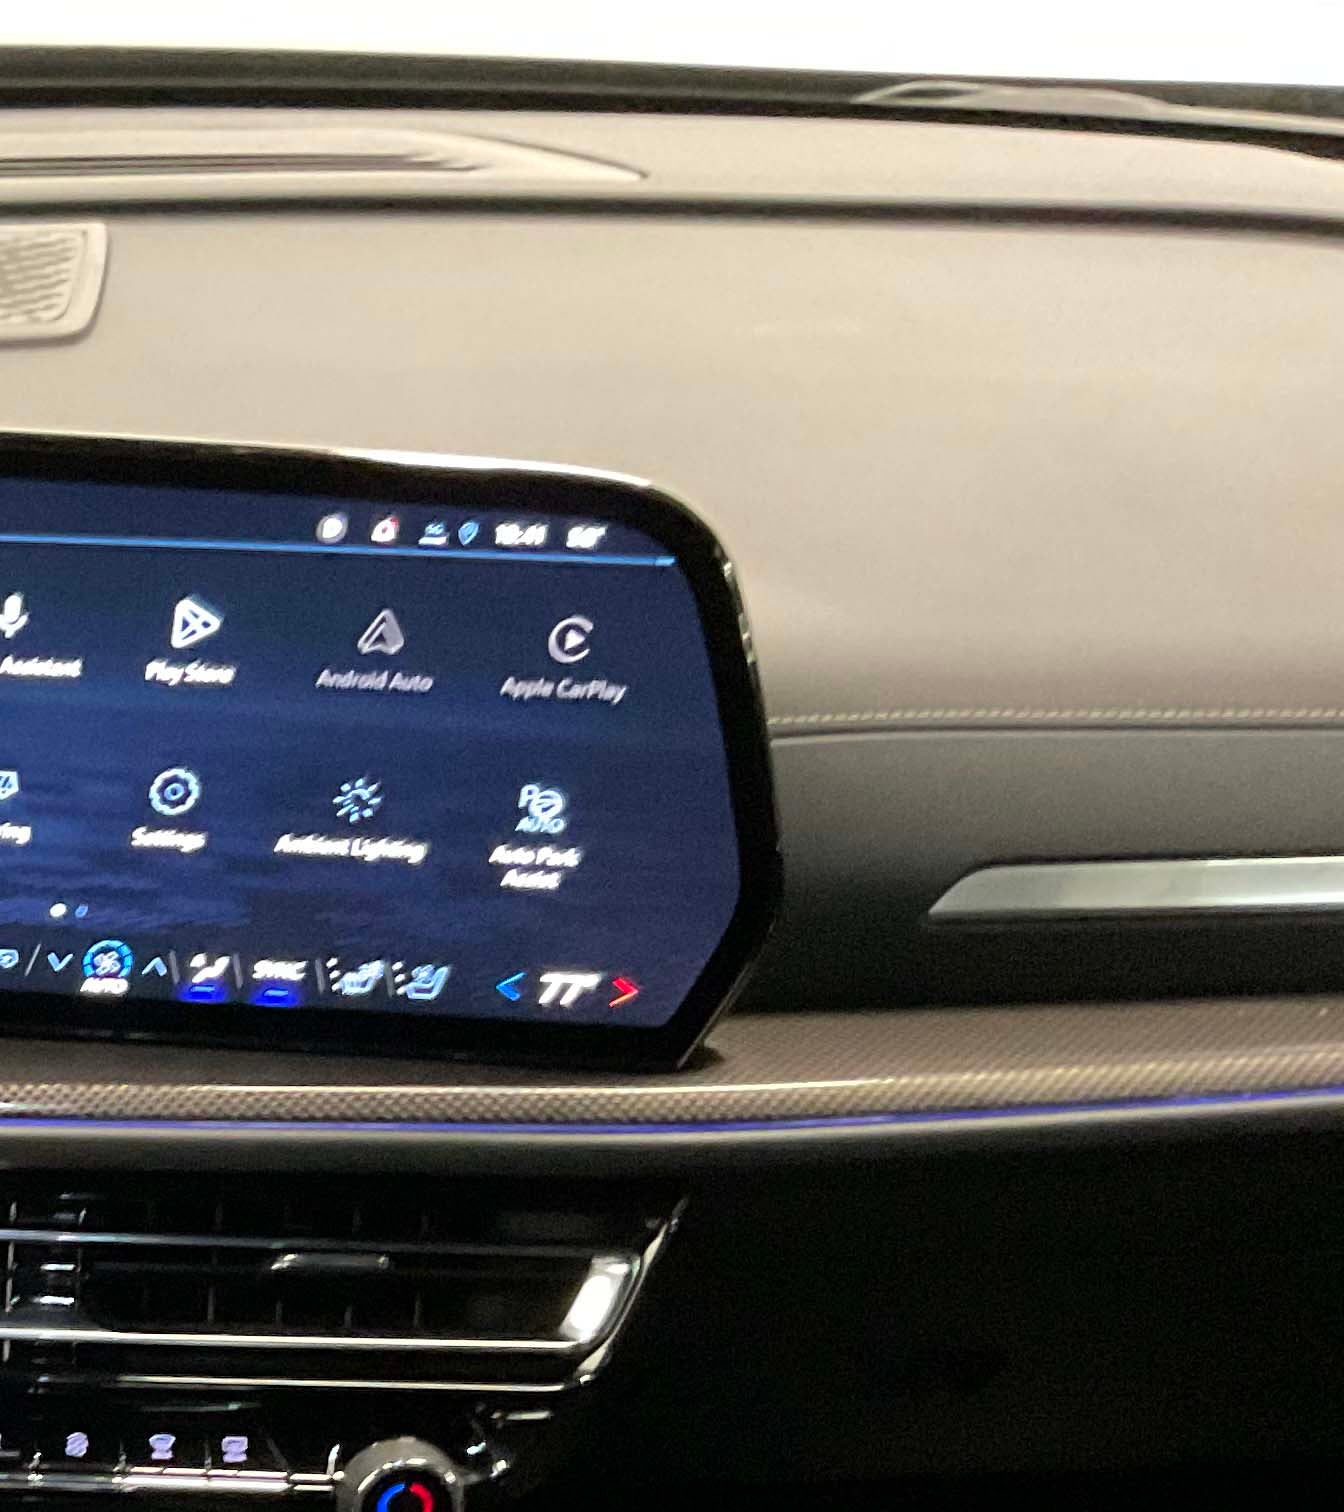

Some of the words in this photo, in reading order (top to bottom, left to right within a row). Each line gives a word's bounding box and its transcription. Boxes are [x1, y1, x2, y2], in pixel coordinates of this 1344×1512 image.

[316, 669, 389, 691] Android
[389, 671, 434, 693] Auto
[500, 676, 555, 700] Apple
[557, 678, 627, 705] CarPlay
